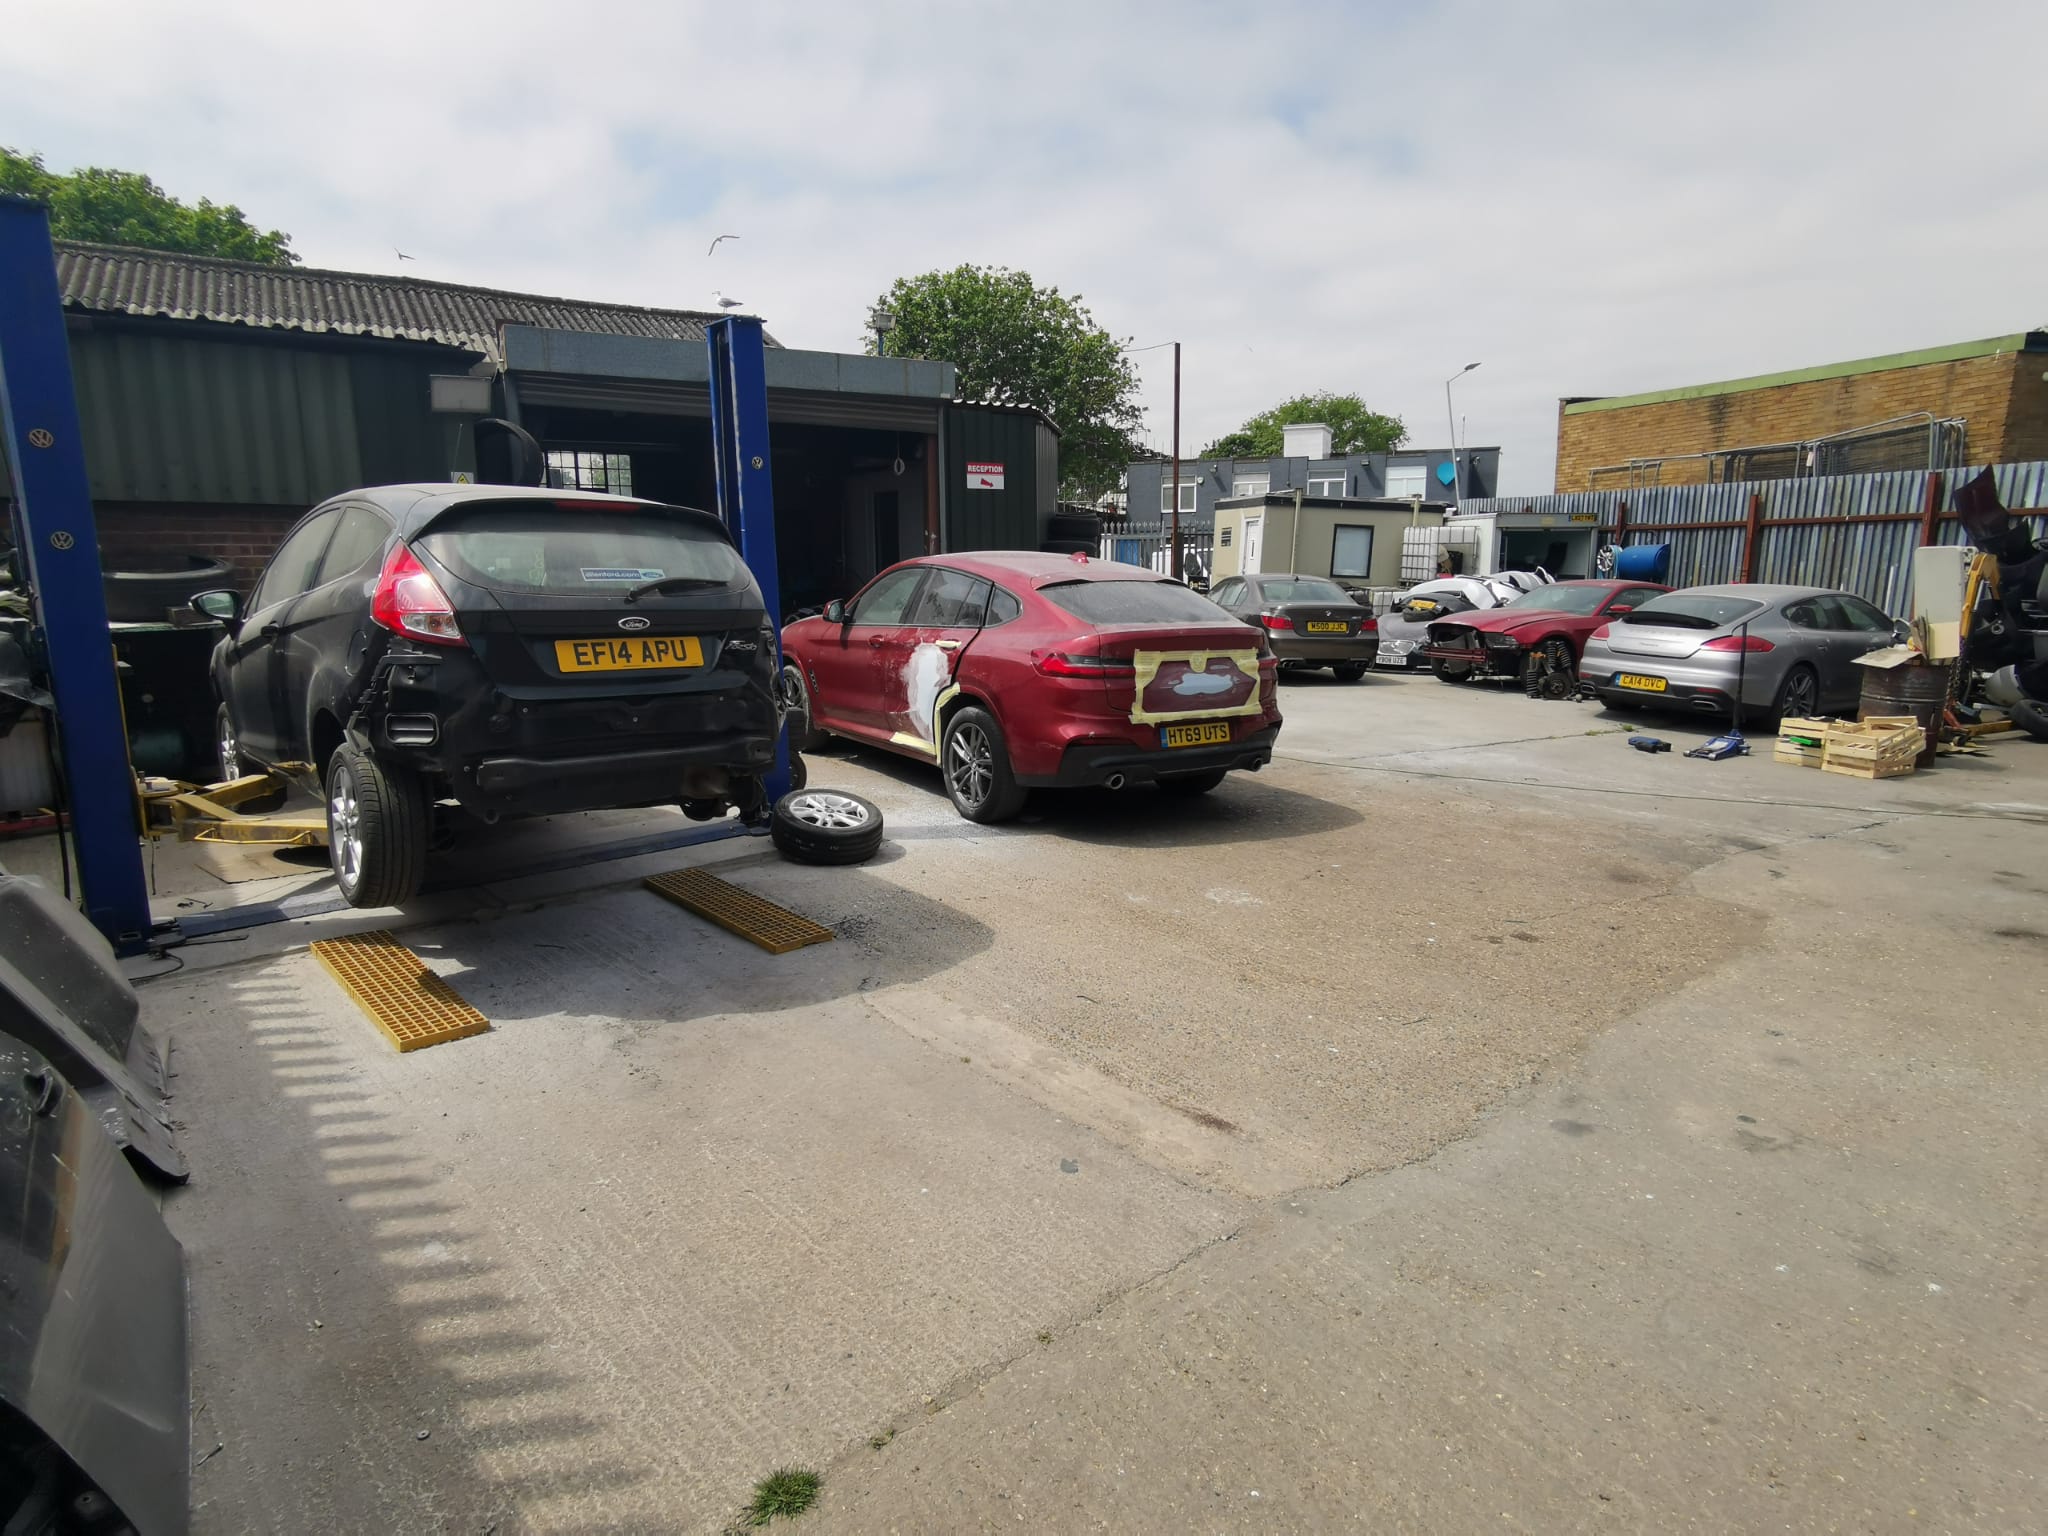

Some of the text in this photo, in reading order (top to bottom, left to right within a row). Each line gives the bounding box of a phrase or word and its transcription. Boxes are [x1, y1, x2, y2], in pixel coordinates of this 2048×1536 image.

[967, 464, 1003, 473] RECEPTION
[573, 639, 688, 666] EF14 APU
[1168, 724, 1227, 744] HT69 UTS
